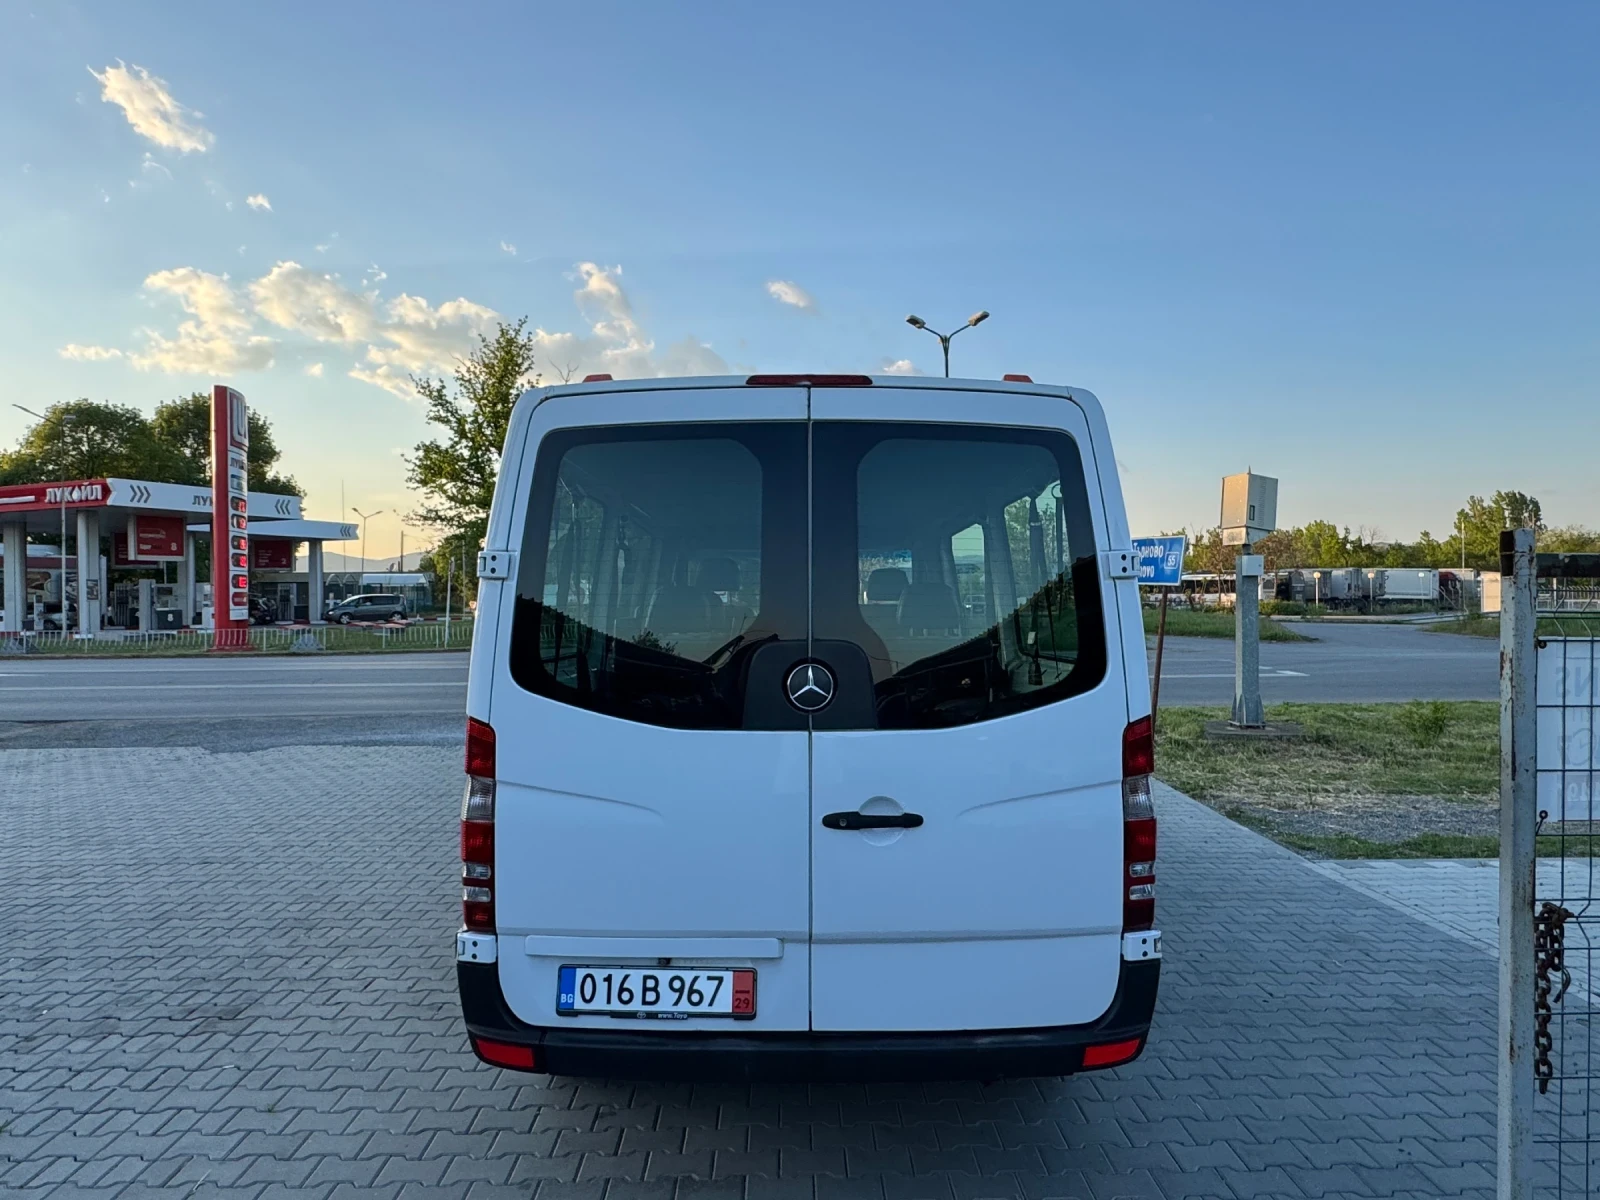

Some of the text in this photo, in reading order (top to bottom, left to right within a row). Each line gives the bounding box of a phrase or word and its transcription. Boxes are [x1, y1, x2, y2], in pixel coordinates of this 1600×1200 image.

[45, 482, 103, 503] ЛУКОЙЛ
[560, 993, 574, 1003] BG
[734, 997, 750, 1009] 29
